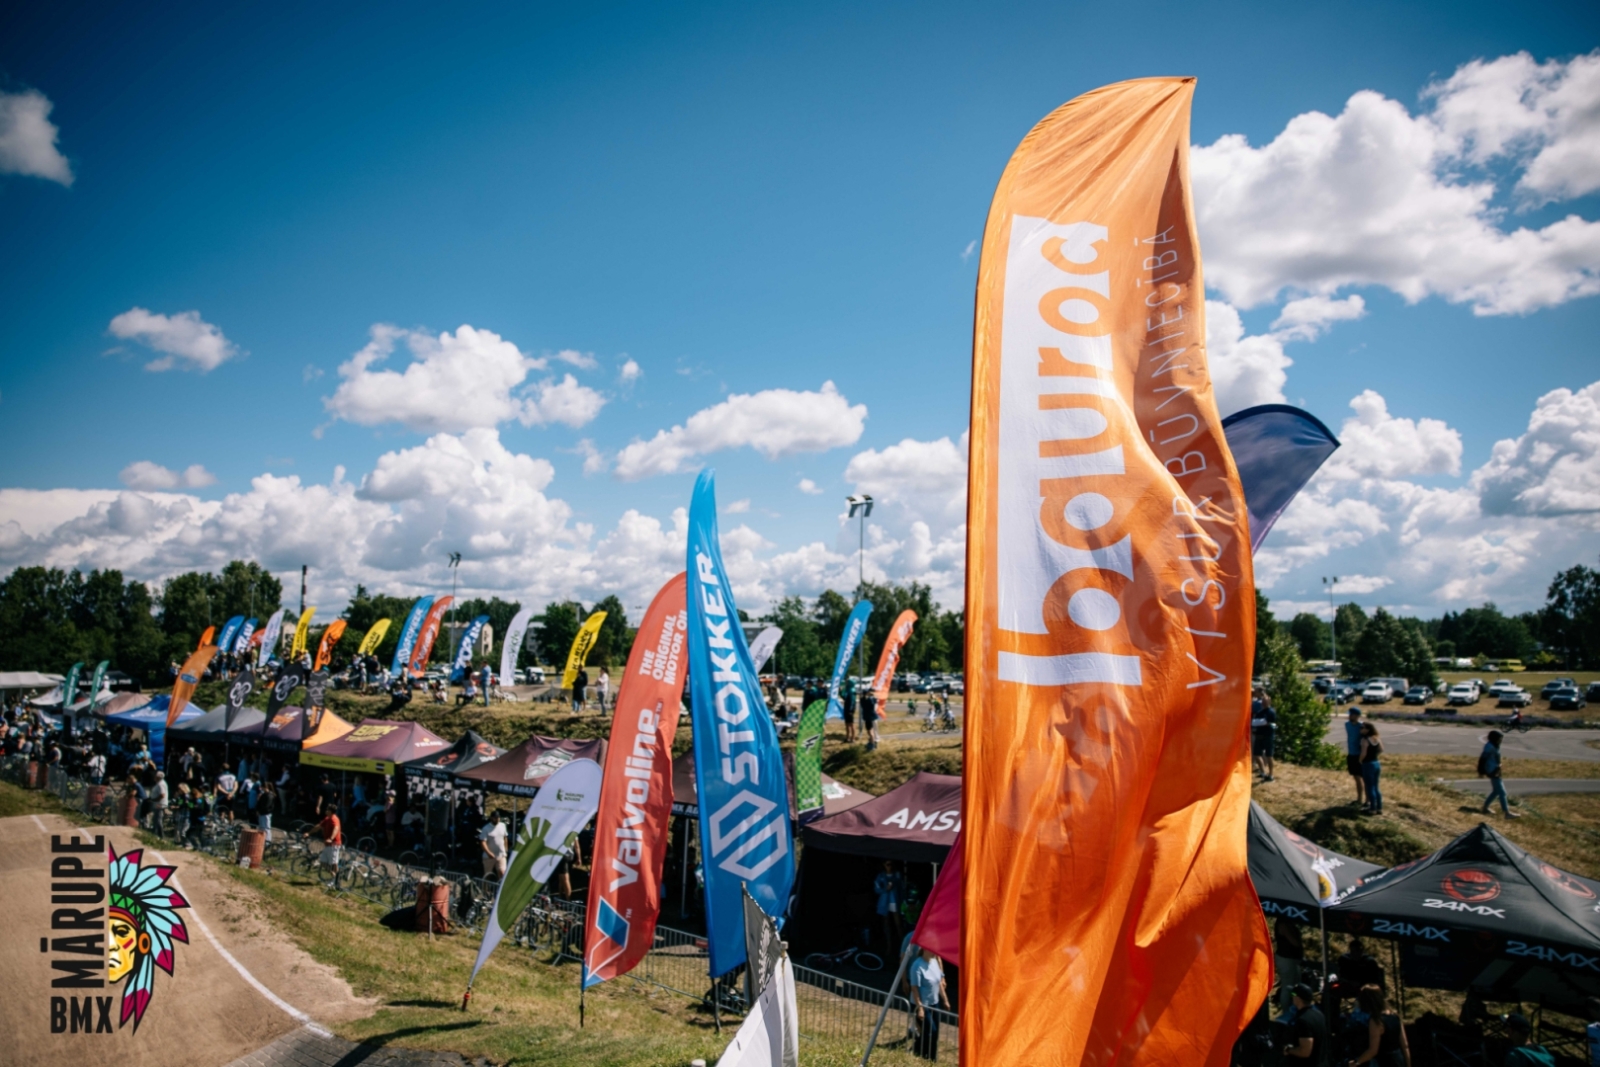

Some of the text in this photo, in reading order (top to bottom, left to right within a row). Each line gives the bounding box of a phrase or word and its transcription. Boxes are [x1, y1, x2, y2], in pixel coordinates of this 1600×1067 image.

[1133, 224, 1227, 689] VISUR BŪVNIECĪBĀ
[639, 649, 655, 676] THE
[652, 614, 677, 681] ORIGINAL
[663, 634, 685, 685] MOTOR
[838, 617, 862, 675] STOKKER
[695, 551, 760, 787] STOKKER
[609, 707, 660, 893] Valvoline
[882, 807, 962, 832] AMS
[1261, 900, 1310, 922] 4MX
[1422, 898, 1506, 919] 24MX
[1373, 919, 1450, 942] 24MX
[1505, 940, 1600, 972] 24MX
